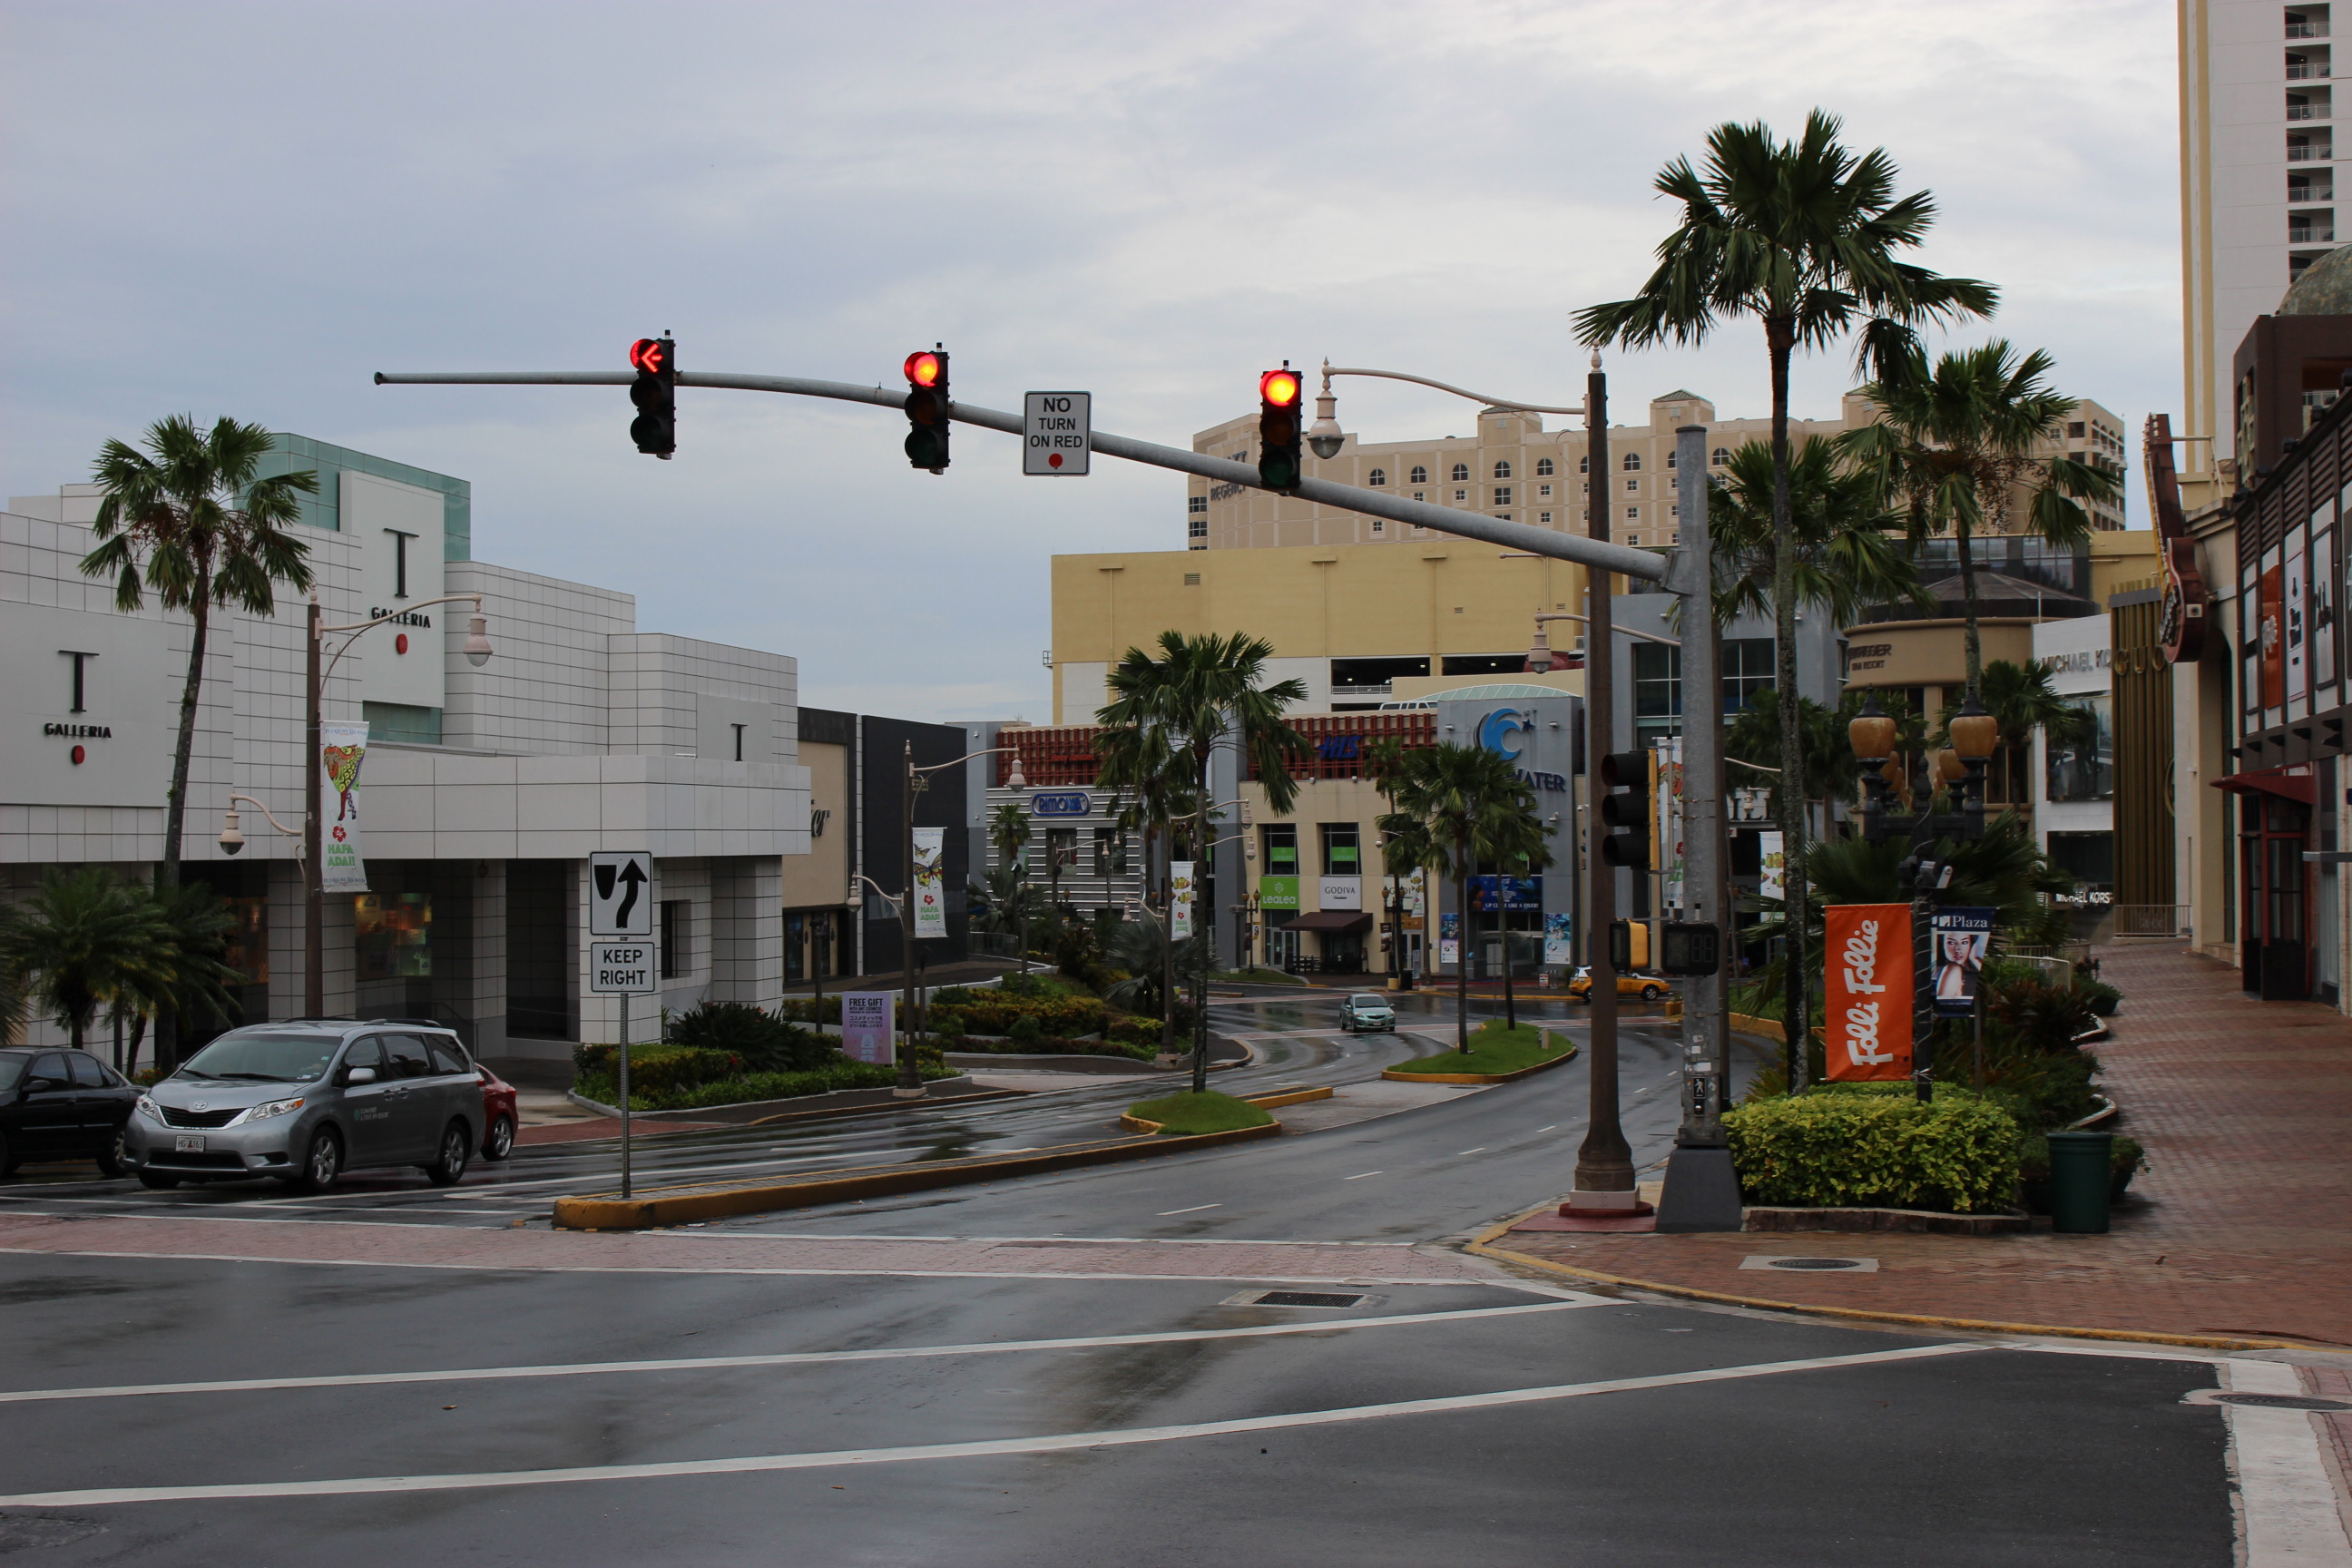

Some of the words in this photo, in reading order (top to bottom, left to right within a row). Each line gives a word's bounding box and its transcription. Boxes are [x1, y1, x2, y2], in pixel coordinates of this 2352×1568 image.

[1044, 397, 1071, 412] NO
[1038, 418, 1075, 430] TURN
[1030, 436, 1050, 447] ON
[1054, 436, 1083, 447] RED
[383, 527, 419, 599] T
[371, 606, 431, 629] GALLERIA
[2095, 649, 2112, 669] KO
[57, 650, 100, 713] T
[44, 722, 112, 739] GALLERIA
[730, 723, 748, 761] T
[2089, 892, 2110, 904] KORS
[1952, 916, 1987, 928] Plaza
[603, 949, 634, 964] KEEP
[1844, 919, 1886, 995] Follie
[592, 970, 637, 985] RIGHT
[849, 998, 867, 1006] FREE
[867, 998, 883, 1006] GIFT
[1846, 1001, 1894, 1066] Folli
